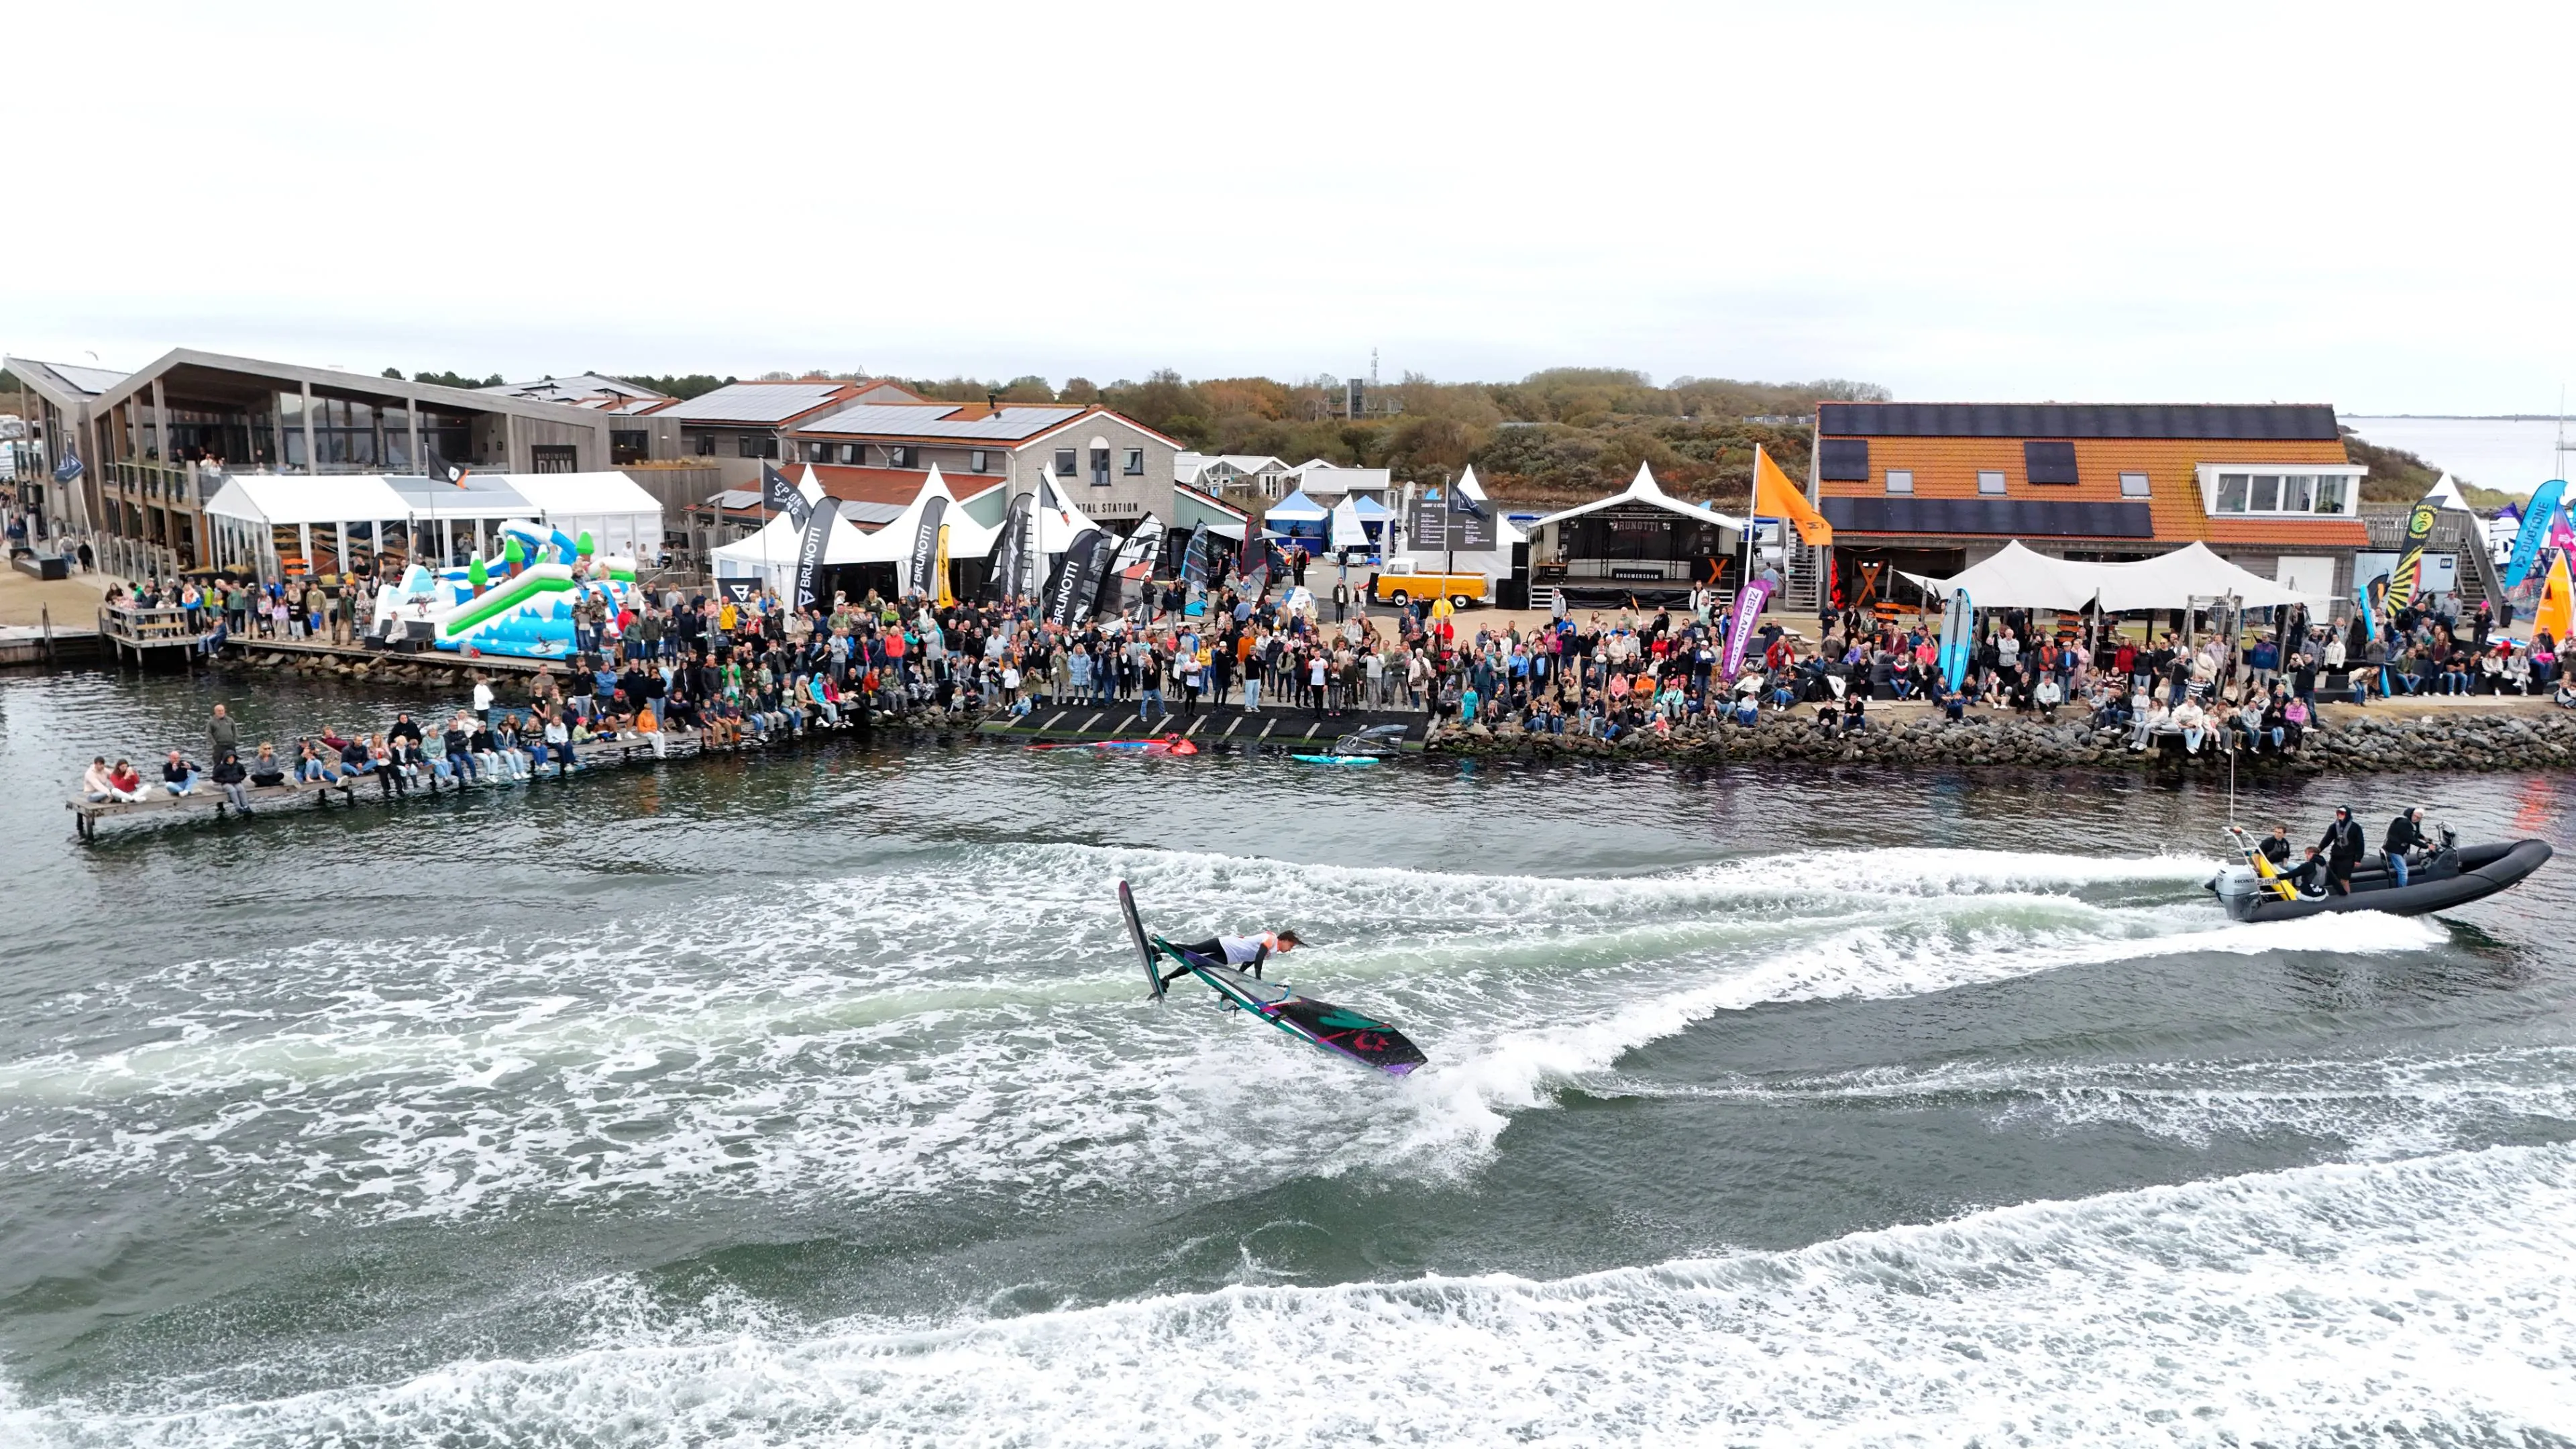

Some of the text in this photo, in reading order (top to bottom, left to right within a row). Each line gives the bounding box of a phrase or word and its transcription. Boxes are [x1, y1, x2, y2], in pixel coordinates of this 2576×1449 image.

[1075, 502, 1138, 513] NTAL STATION
[1615, 521, 1659, 532] RUNOTTI
[2416, 504, 2438, 514] INDO
[2521, 501, 2549, 553] DUOTONE
[800, 527, 821, 588] BRUNOTTI
[914, 524, 932, 583] BRUNOTTI
[1053, 561, 1079, 626] BRUNOTTI
